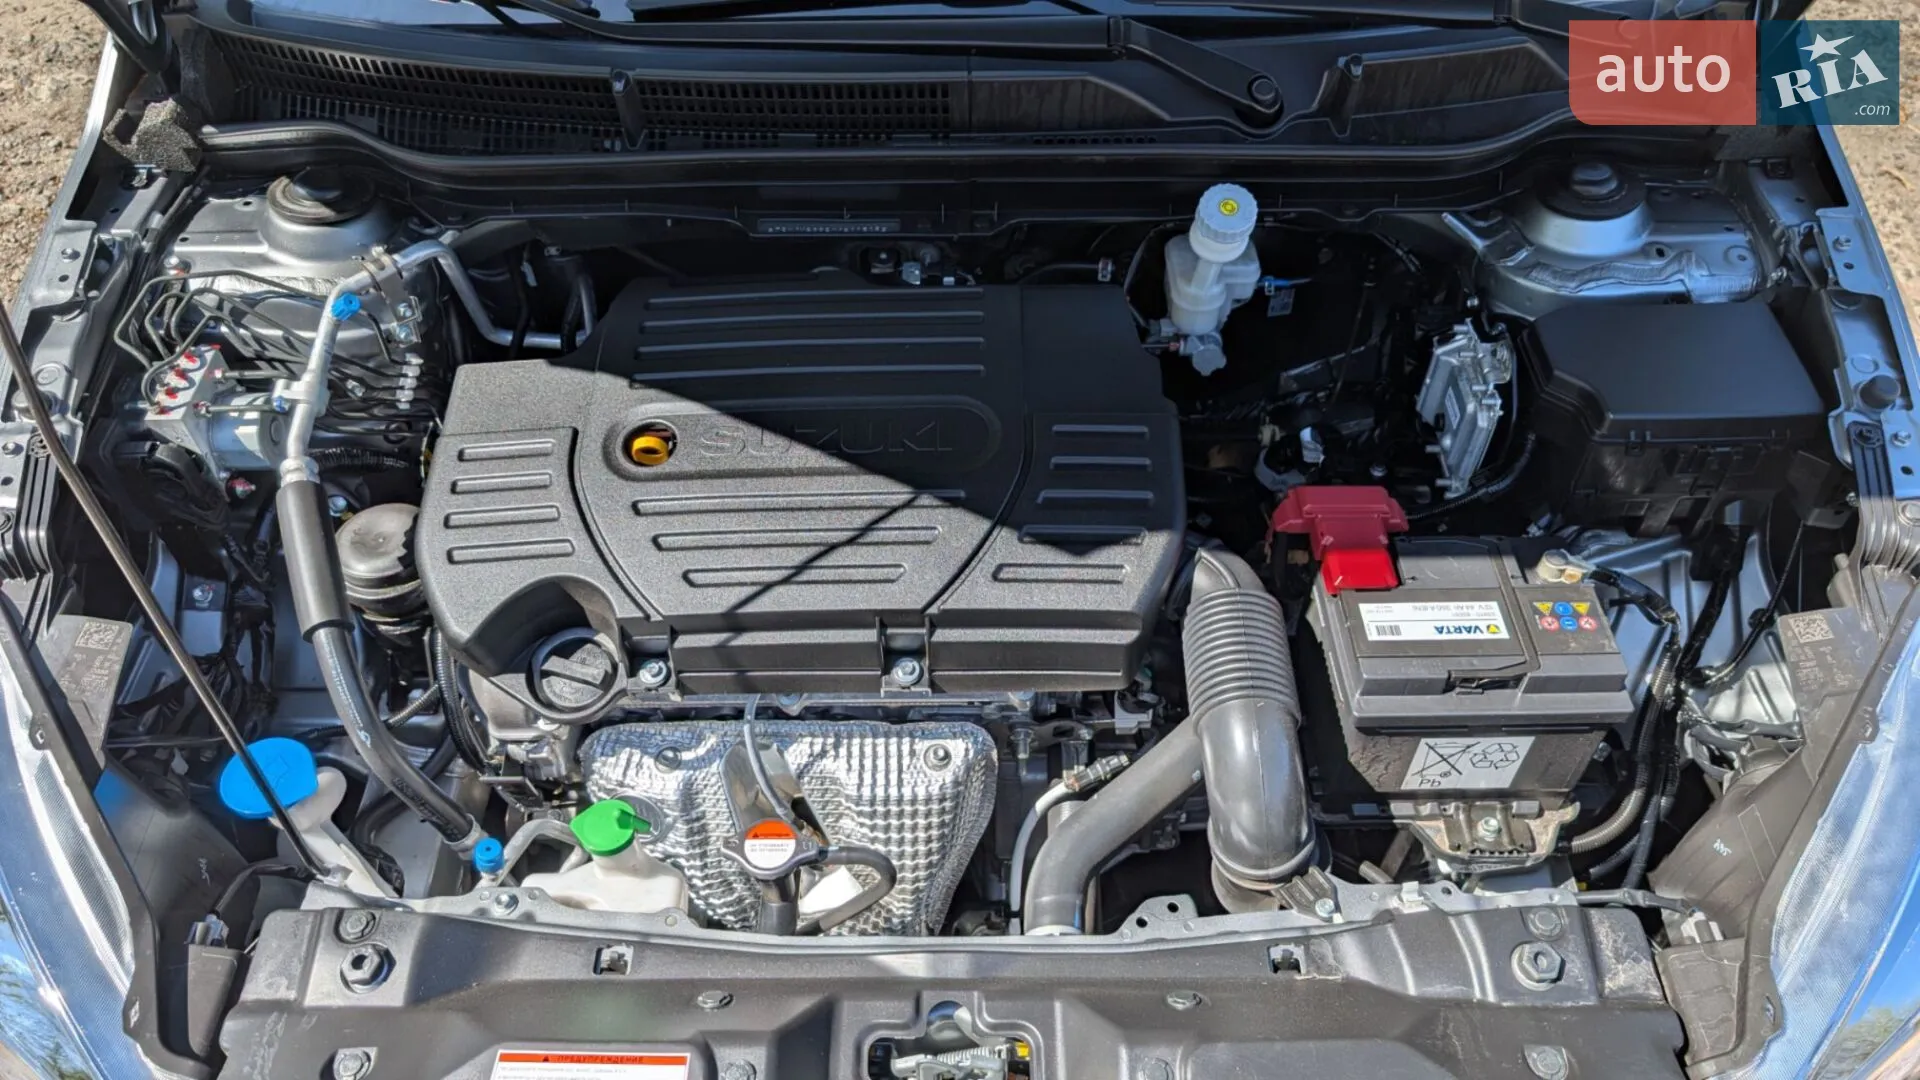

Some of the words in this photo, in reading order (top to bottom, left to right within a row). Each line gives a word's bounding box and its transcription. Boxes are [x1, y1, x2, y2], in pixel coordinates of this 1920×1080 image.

[699, 421, 953, 456] SUZUKI
[1434, 625, 1484, 635] VARTA
[1418, 779, 1442, 788] Pb
